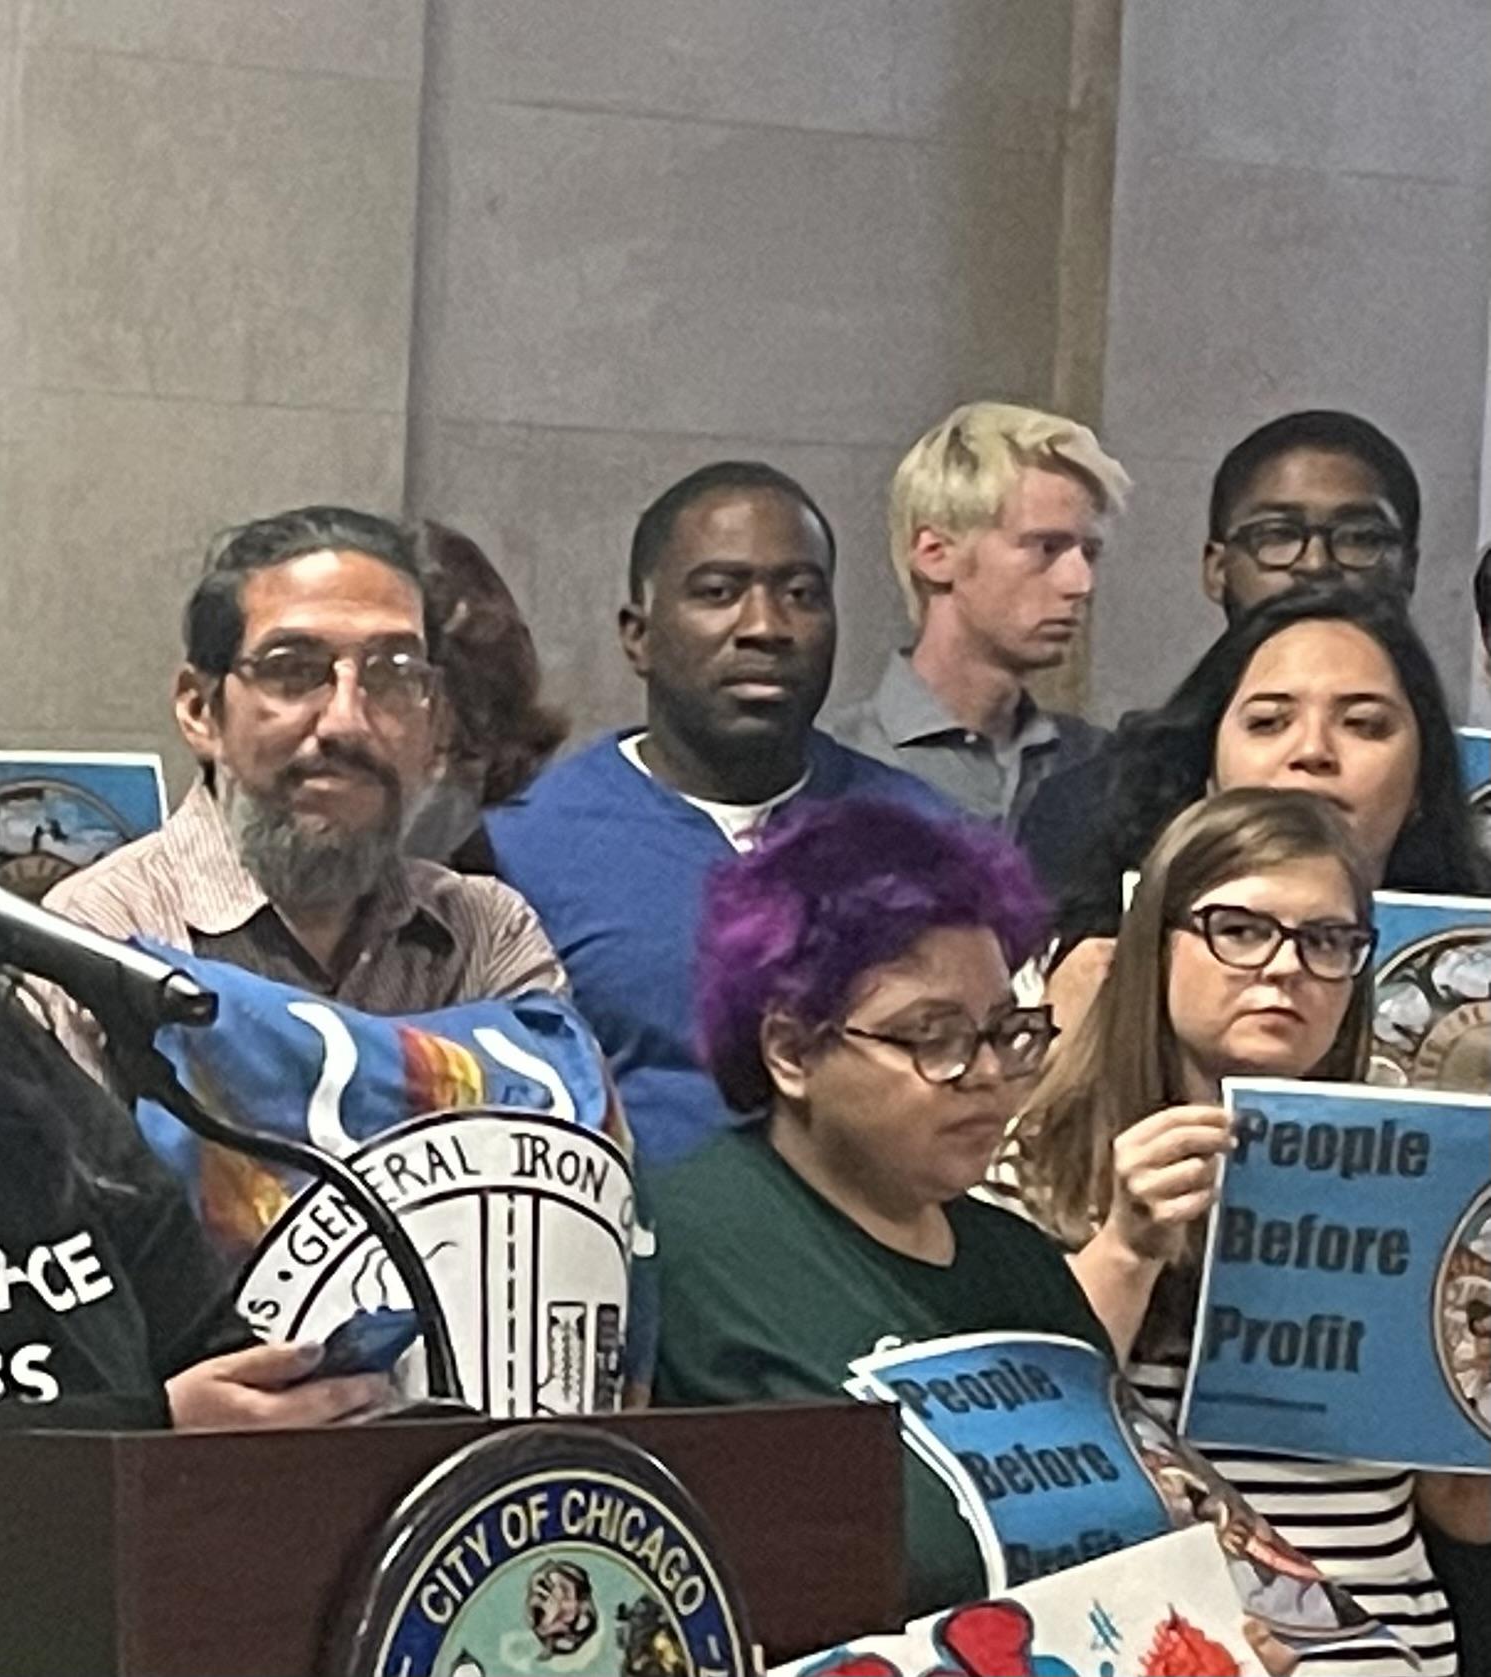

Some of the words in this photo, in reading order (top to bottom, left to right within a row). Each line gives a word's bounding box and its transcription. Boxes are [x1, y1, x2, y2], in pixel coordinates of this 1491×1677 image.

[509, 1133, 610, 1203] IRON
[1231, 1108, 1431, 1180] People
[1218, 1206, 1409, 1277] Before
[1207, 1304, 1366, 1374] Profit
[889, 1358, 1064, 1420] People
[956, 1443, 1121, 1500] Before
[419, 1523, 493, 1625] CITY
[500, 1493, 550, 1550] OF
[560, 1488, 707, 1616] CHICAGO
